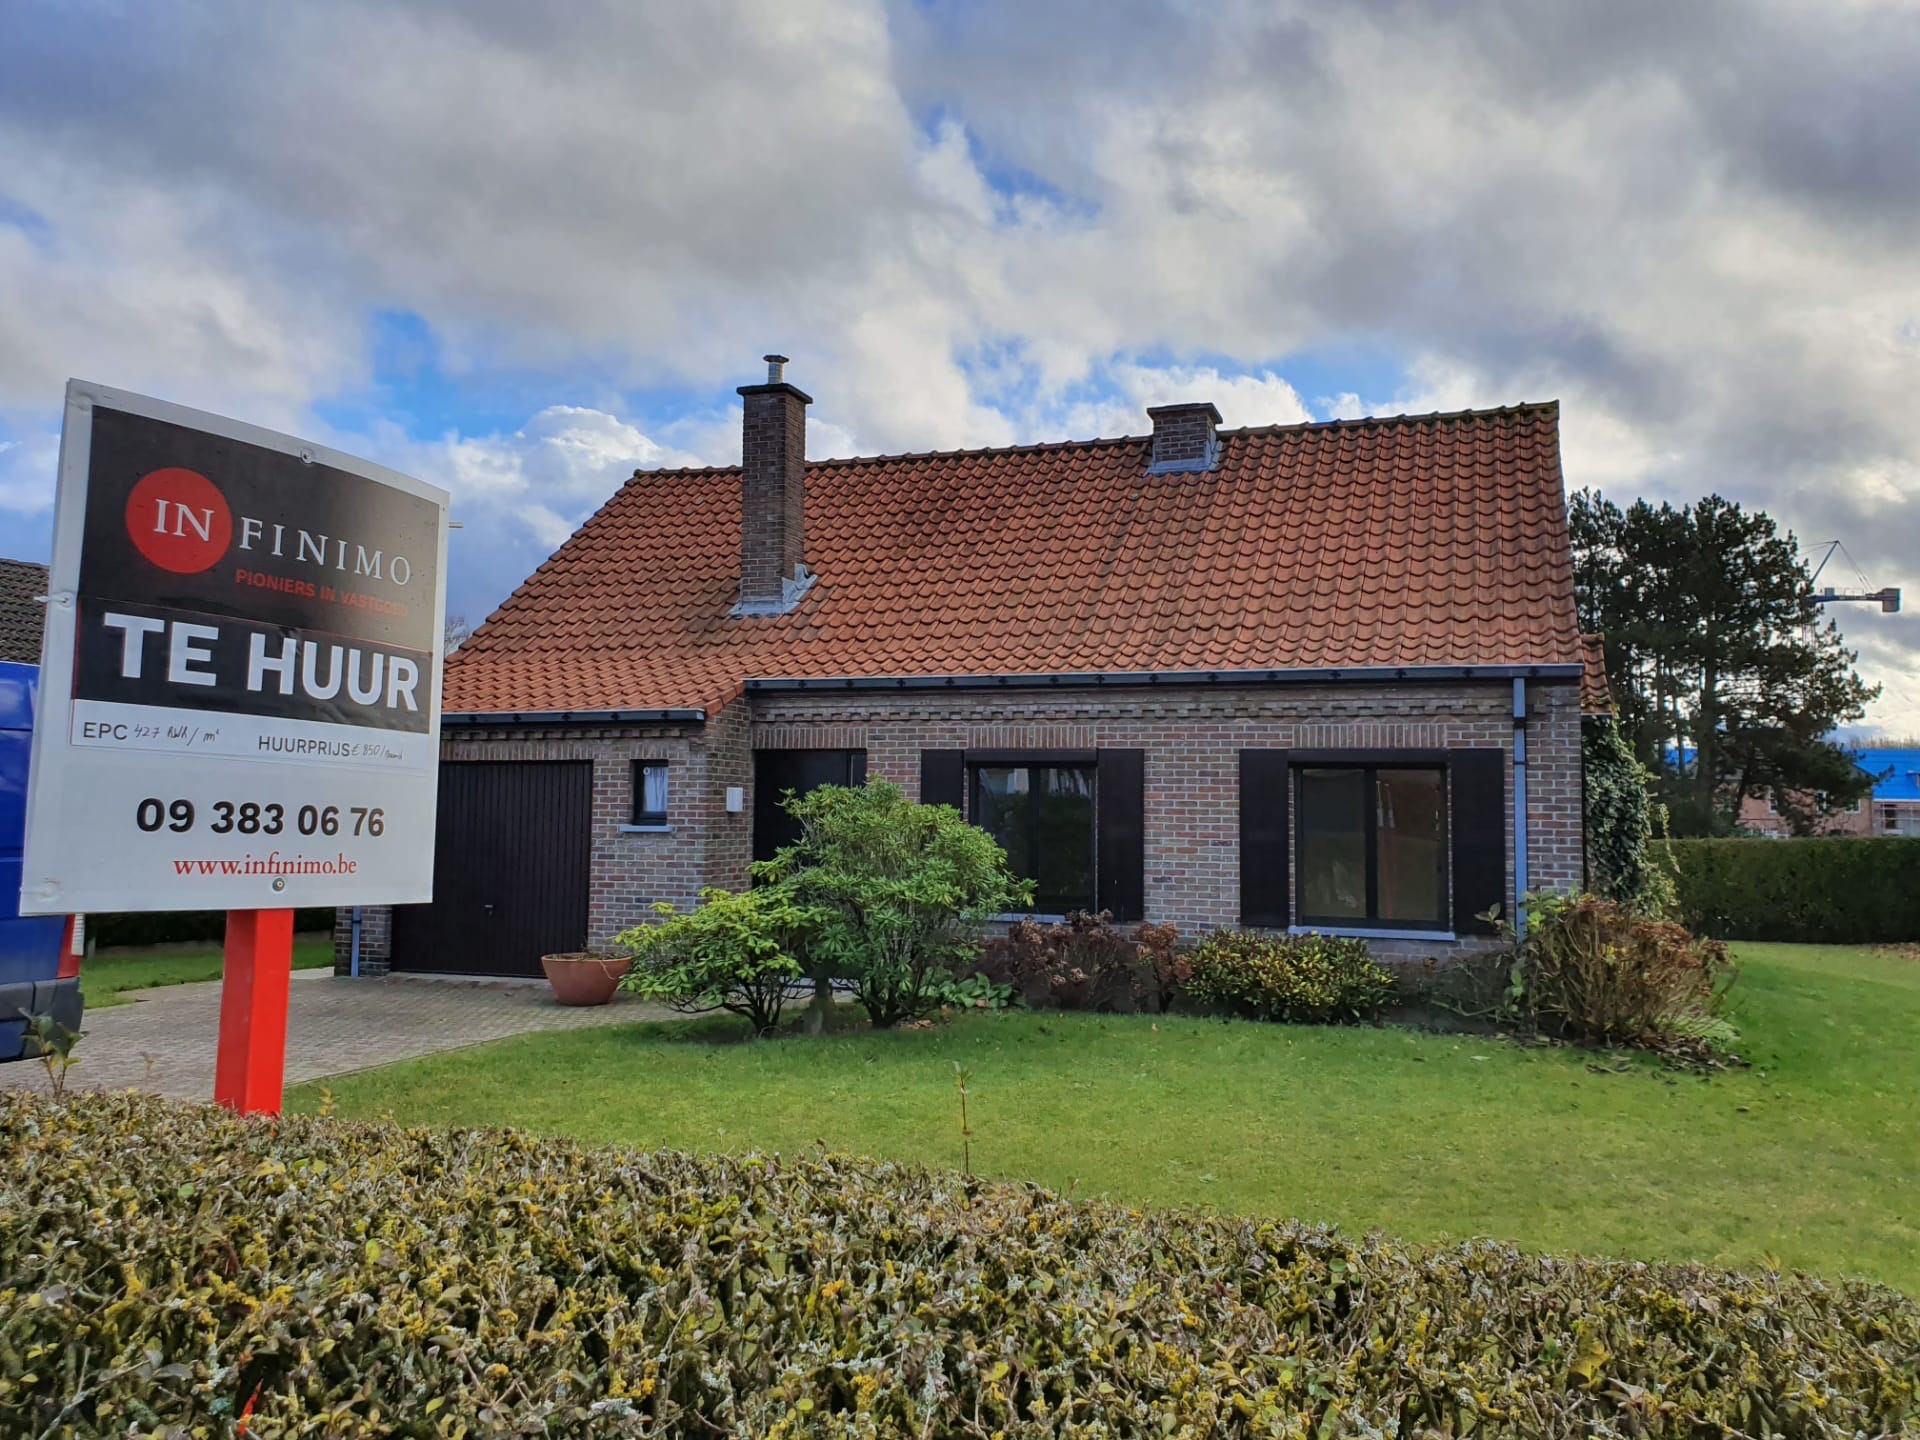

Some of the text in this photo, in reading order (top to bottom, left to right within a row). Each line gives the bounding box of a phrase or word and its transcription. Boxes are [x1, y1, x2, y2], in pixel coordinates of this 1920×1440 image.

[154, 499, 412, 586] IN FINIMO
[235, 569, 316, 597] PIONIERS
[320, 585, 336, 601] IN
[103, 612, 419, 713] TE HUUR
[83, 722, 128, 740] EPC
[258, 735, 350, 757] HUURPRIJS
[136, 798, 385, 837] 09 383 06 76
[173, 850, 357, 876] www.infinimo.be
